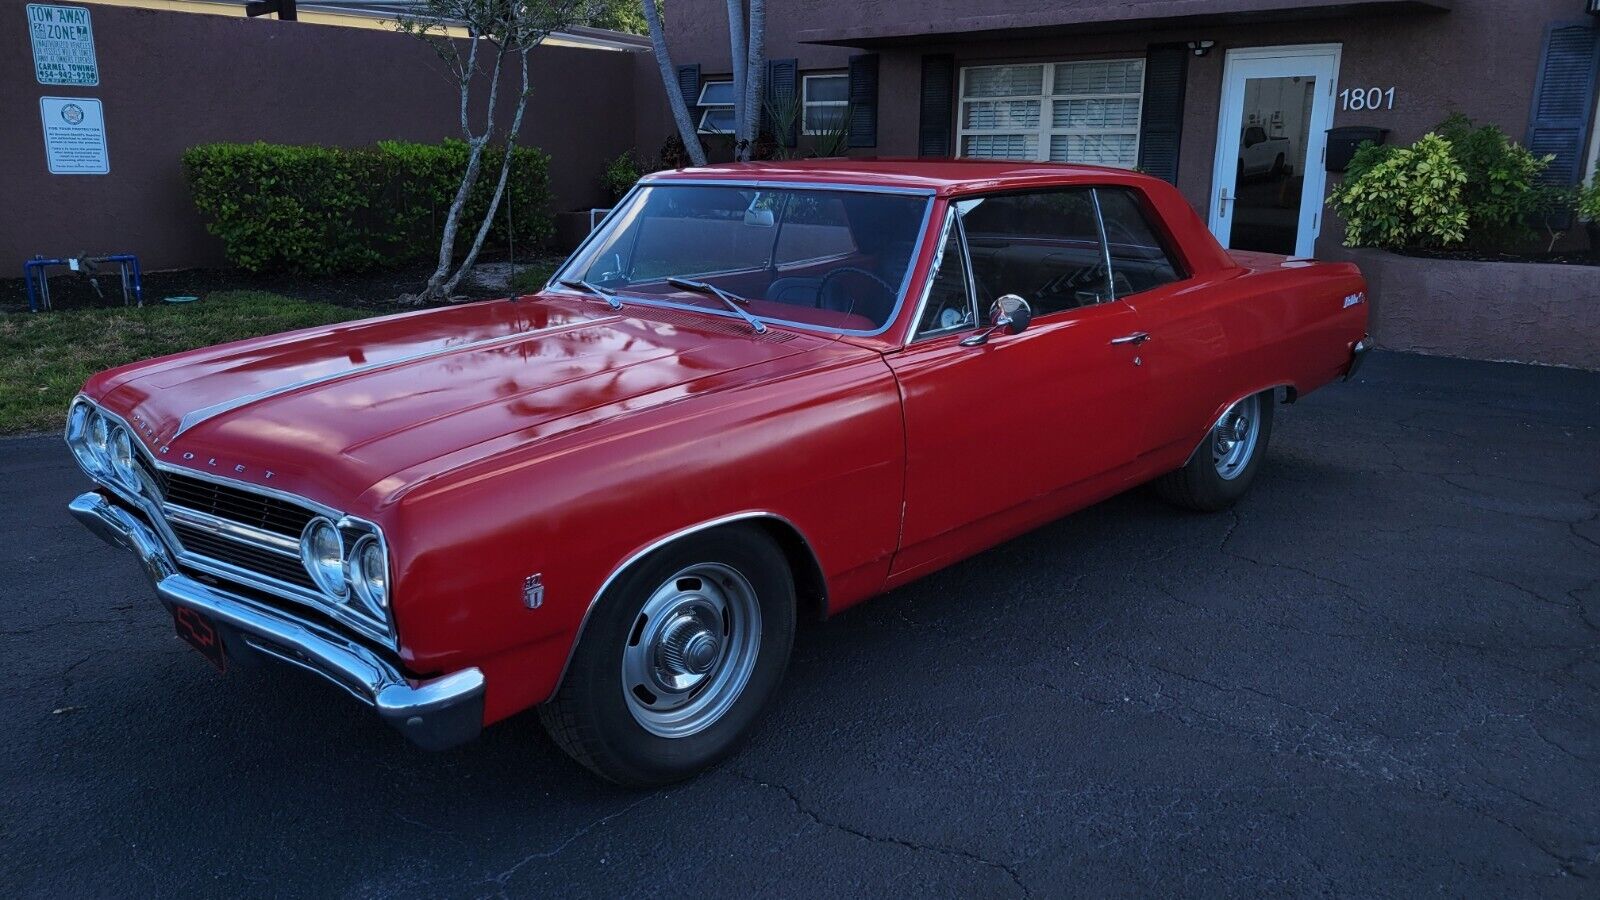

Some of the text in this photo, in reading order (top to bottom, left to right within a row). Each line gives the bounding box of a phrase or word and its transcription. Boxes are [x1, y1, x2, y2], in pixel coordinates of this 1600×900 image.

[30, 7, 86, 24] TOW AWAY
[47, 25, 76, 40] ZONE
[38, 63, 95, 72] CARMEL TOWING
[1340, 87, 1395, 111] 1801
